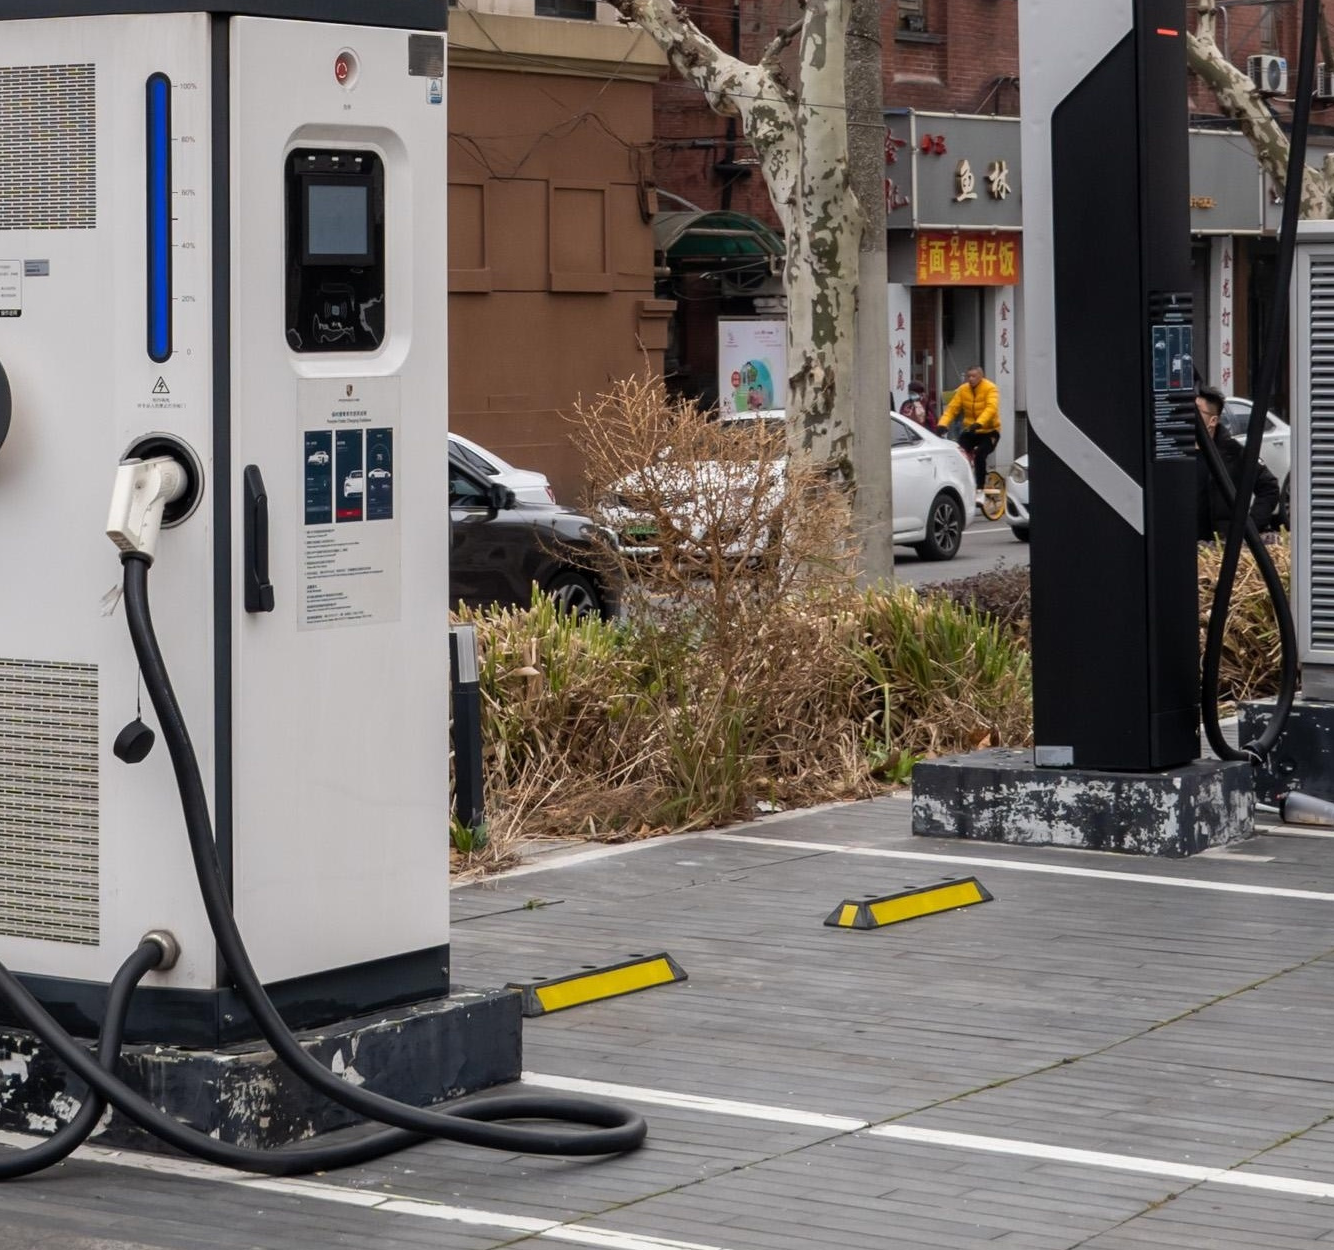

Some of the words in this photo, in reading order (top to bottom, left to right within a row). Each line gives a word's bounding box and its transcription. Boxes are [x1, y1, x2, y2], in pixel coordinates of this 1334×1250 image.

[929, 240, 946, 274] 面
[963, 240, 1014, 277] 煲仔饭
